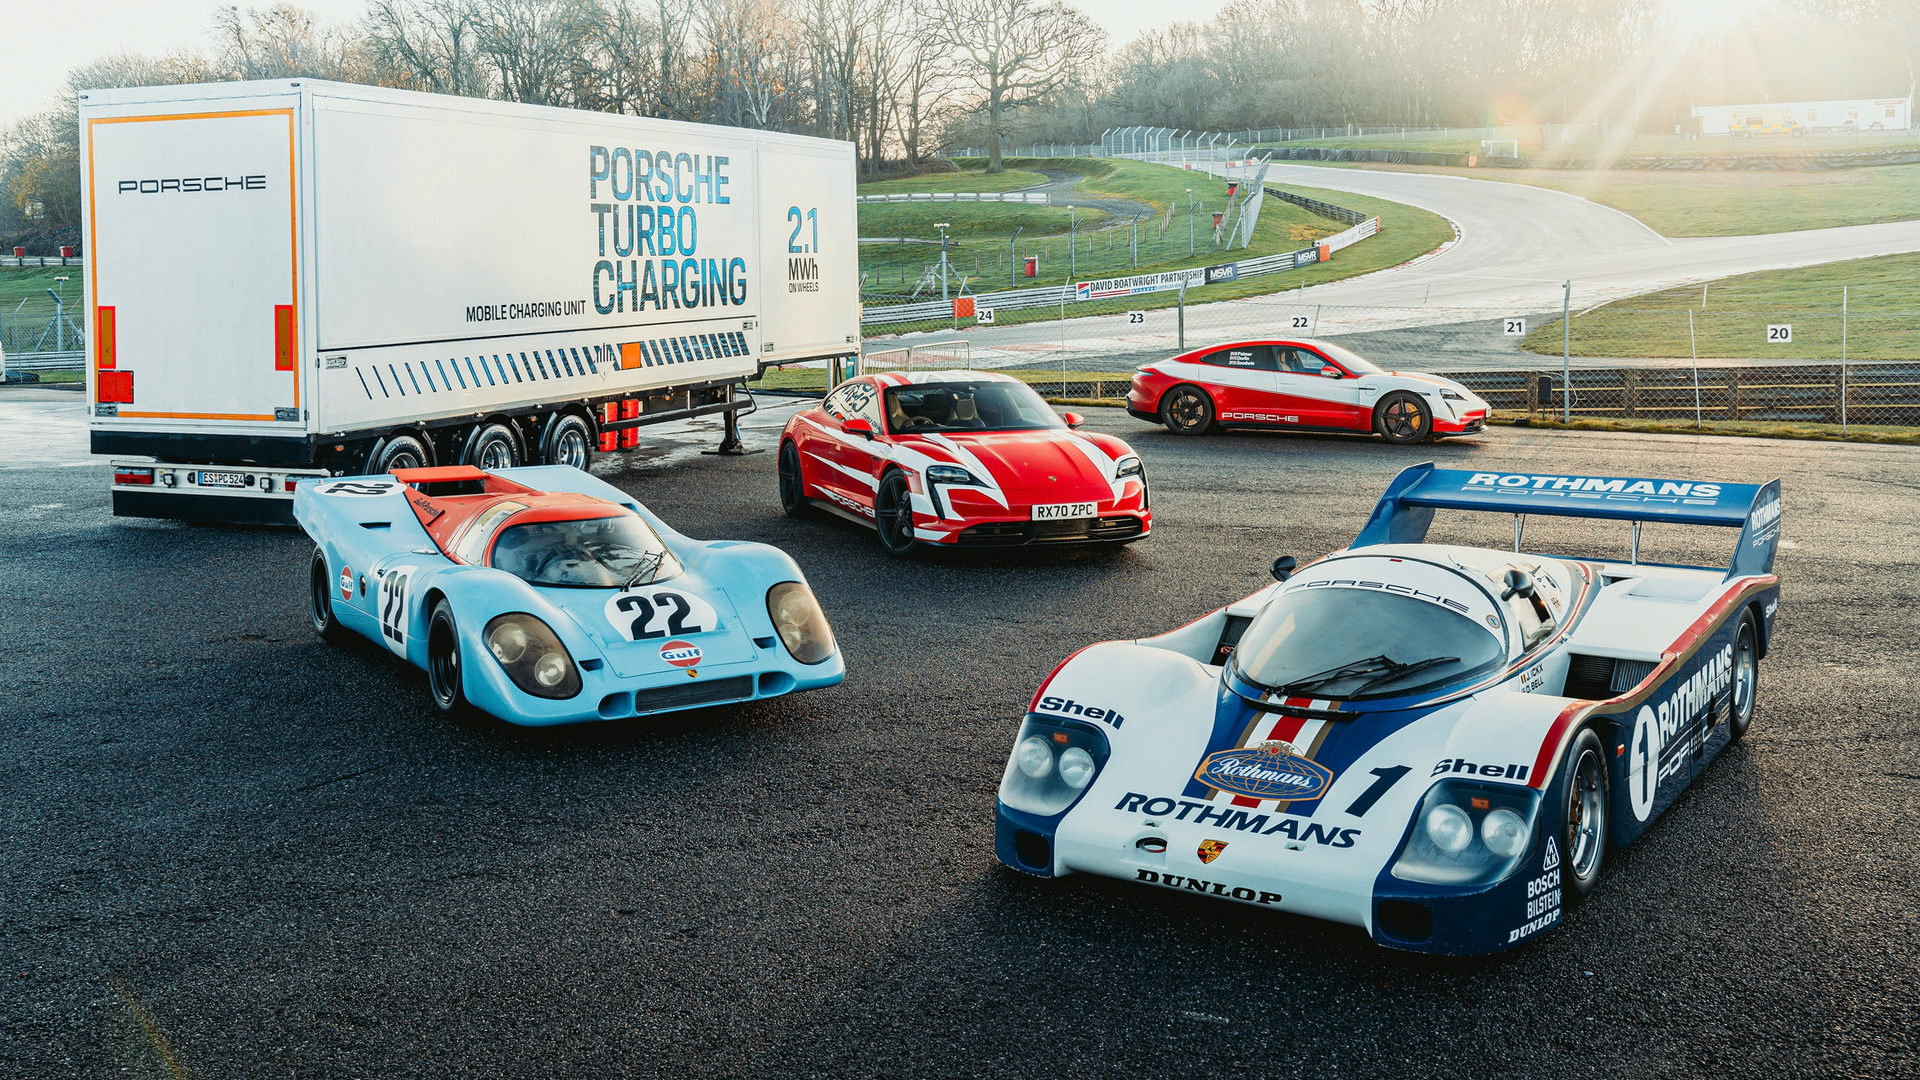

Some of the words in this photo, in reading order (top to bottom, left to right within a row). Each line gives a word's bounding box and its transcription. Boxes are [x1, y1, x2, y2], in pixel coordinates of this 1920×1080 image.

[119, 175, 266, 194] PORSCHE
[590, 145, 730, 204] PORSCHE
[590, 203, 697, 257] TURBO
[788, 206, 818, 253] 2.1
[789, 258, 818, 280] MWh
[1210, 267, 1233, 279] MSVR
[593, 257, 747, 315] CHARGING
[789, 282, 797, 293] ON
[797, 282, 819, 292] WHEELS
[1090, 280, 1112, 292] DAVID
[1114, 274, 1159, 289] BOATWRIGHT
[466, 305, 507, 322] MOBILE
[509, 301, 561, 318] CHARGING
[564, 300, 586, 315] UNIT
[979, 311, 992, 320] 24
[1130, 314, 1143, 323] 23
[1293, 317, 1308, 327] 22
[1507, 322, 1521, 332] 21
[1770, 327, 1788, 339] 20
[1221, 412, 1299, 422] PORSCHE
[203, 473, 214, 483] ES
[218, 475, 228, 484] PC
[229, 475, 243, 484] 524
[1467, 473, 1722, 497] ROTHMANS
[1461, 486, 1719, 506] PORSCHE
[1038, 505, 1068, 518] RX70
[1071, 504, 1093, 516] ZPC
[341, 577, 353, 590] Gulf
[384, 570, 408, 644] 22
[1285, 580, 1470, 614] PORSCHE
[616, 592, 702, 640] 22
[661, 649, 701, 660] Gulf
[1658, 643, 1733, 749] ROTHMANS
[1040, 696, 1125, 730] Shell
[1212, 758, 1313, 788] Rothmans
[1430, 758, 1529, 780] Shell
[1638, 720, 1648, 806] 1
[1345, 764, 1413, 818] 1
[1114, 792, 1362, 849] ROTHMANS
[1135, 868, 1282, 905] DUNLOP
[1527, 868, 1560, 899] BOSCH
[1527, 888, 1560, 919] BILSTEIN
[1508, 908, 1560, 943] DUNLOP
